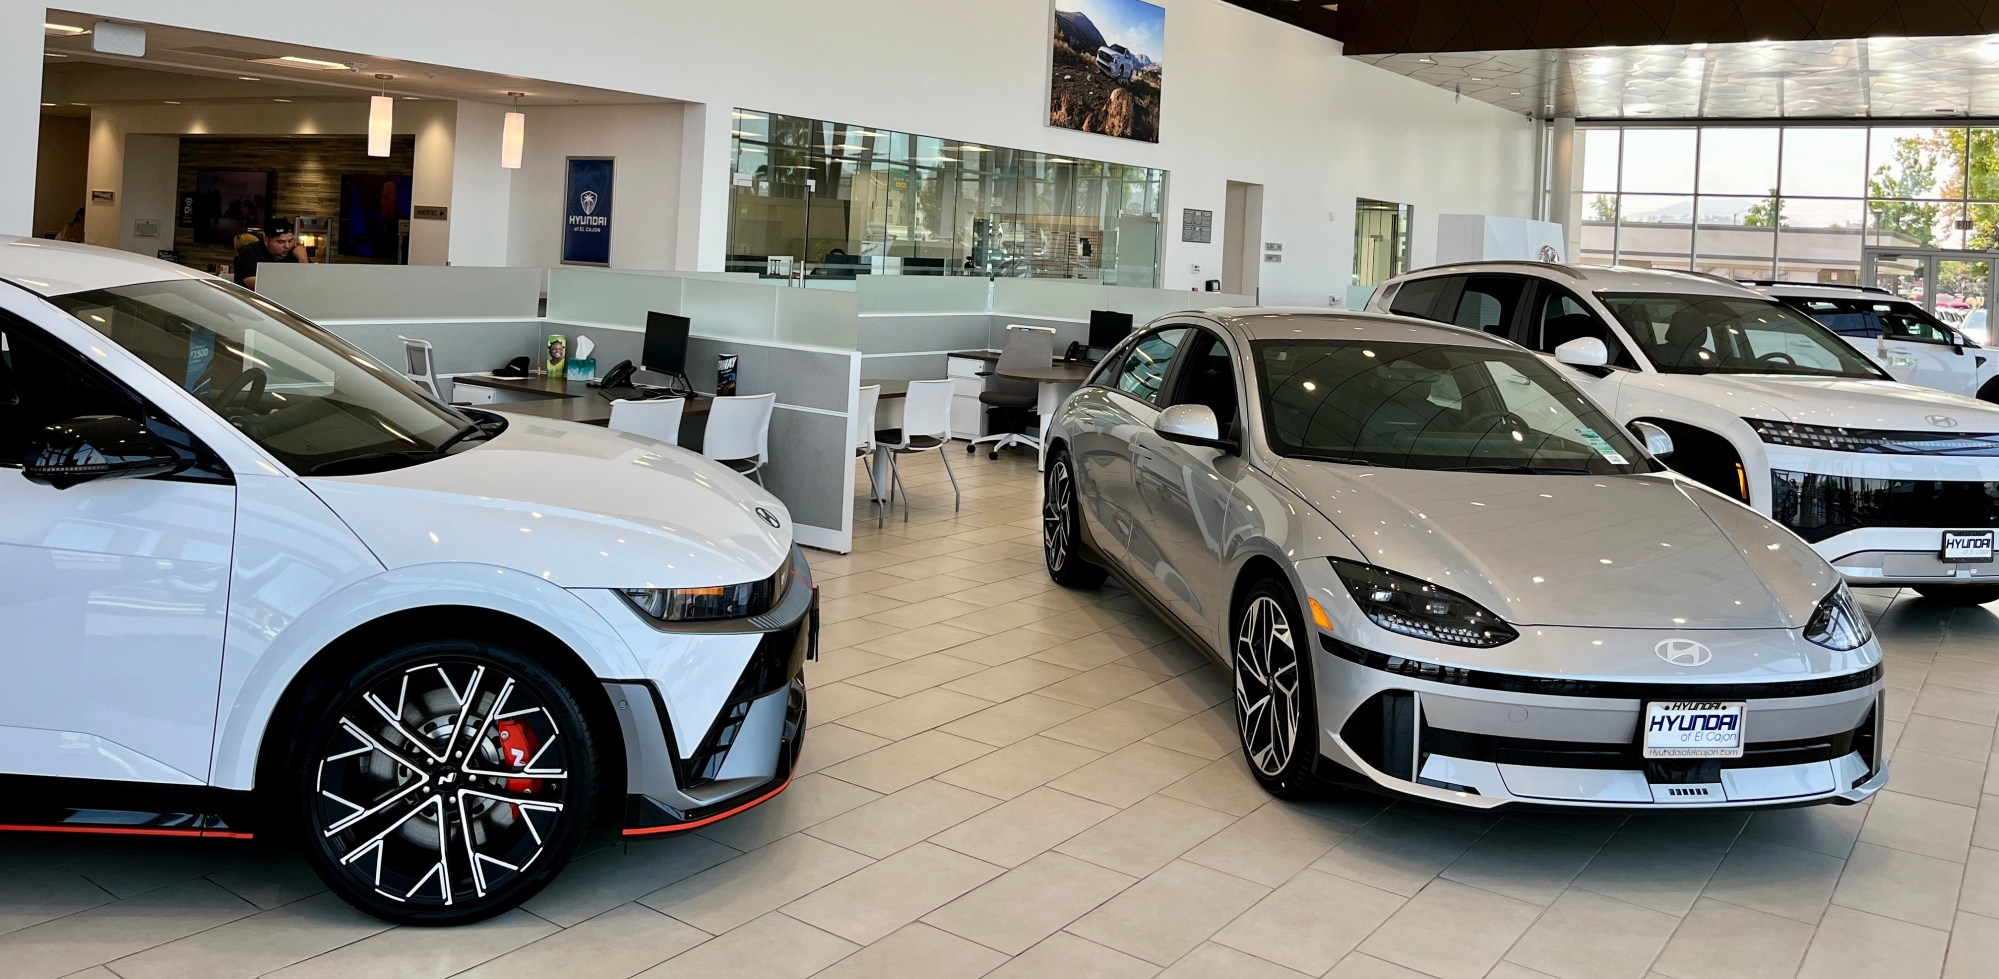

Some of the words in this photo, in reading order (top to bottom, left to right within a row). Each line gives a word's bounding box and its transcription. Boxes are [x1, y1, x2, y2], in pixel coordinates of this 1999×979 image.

[569, 215, 607, 226] HYUNDAI
[1946, 538, 1991, 549] HYUNDAI
[1672, 702, 1721, 711] HYUNDAI
[1649, 714, 1739, 732] HYUNDAI
[1680, 731, 1693, 742] of
[1694, 731, 1704, 742] El
[1705, 731, 1738, 744] Cajon
